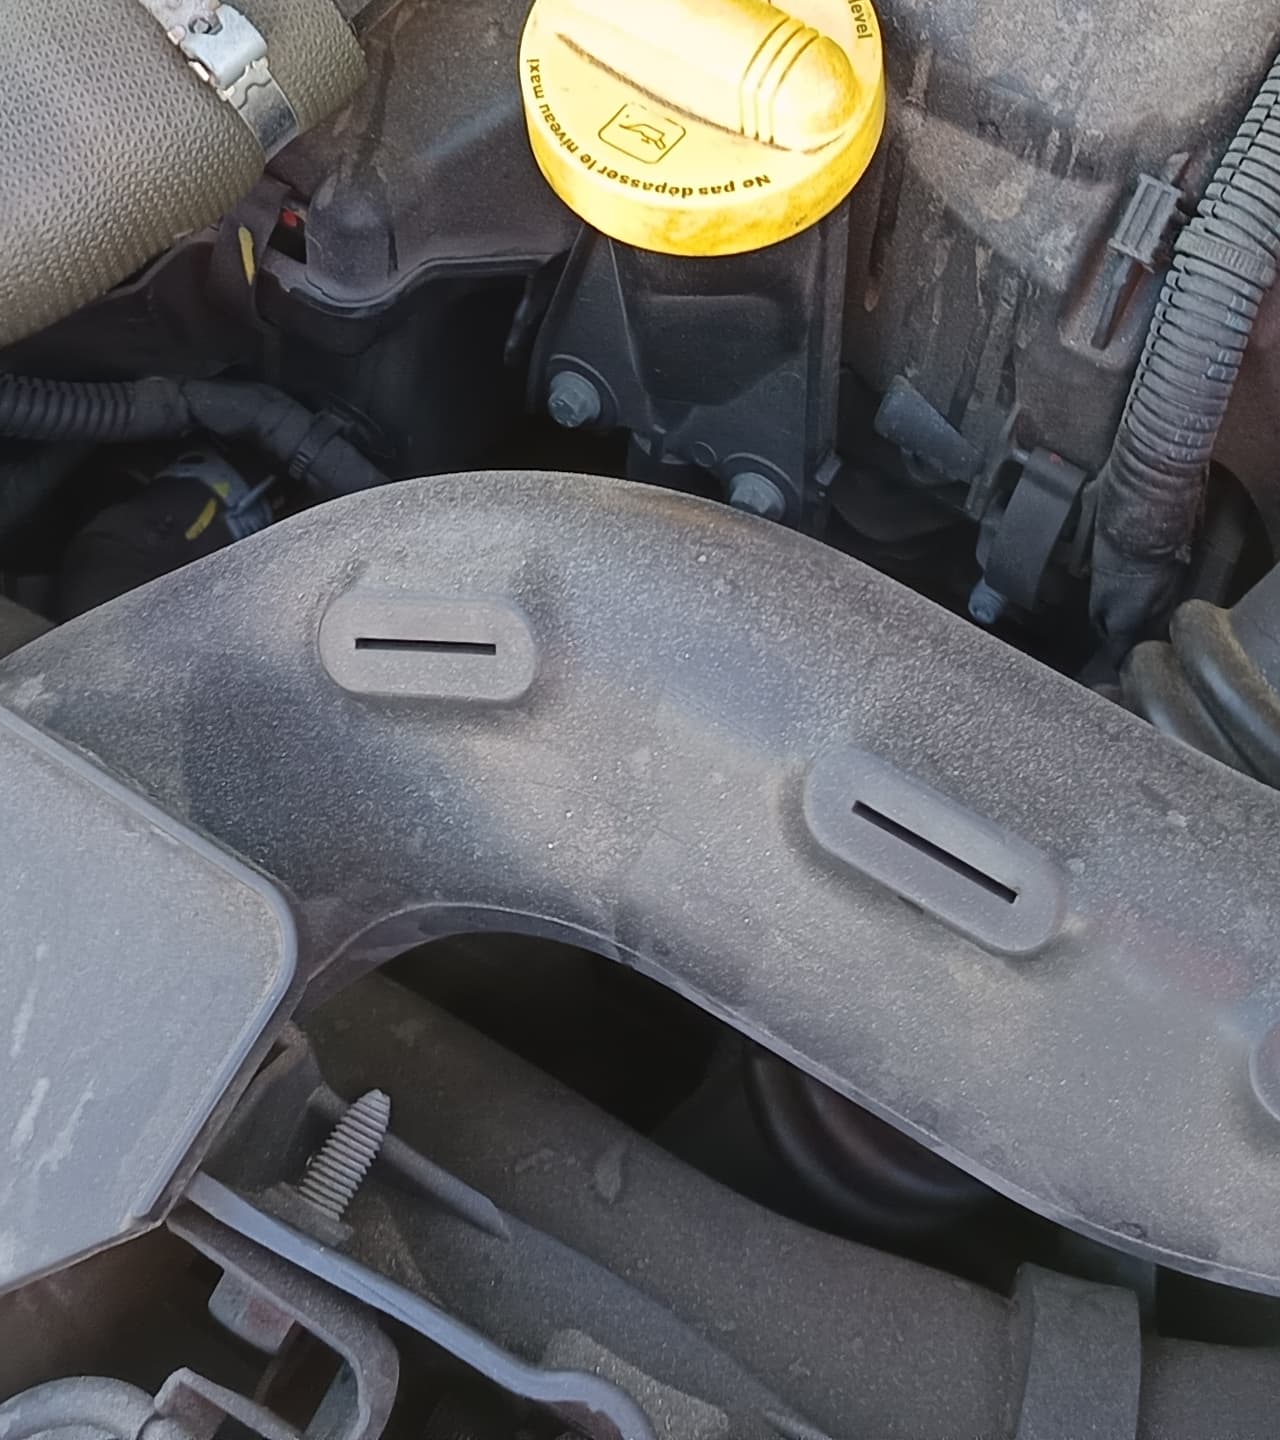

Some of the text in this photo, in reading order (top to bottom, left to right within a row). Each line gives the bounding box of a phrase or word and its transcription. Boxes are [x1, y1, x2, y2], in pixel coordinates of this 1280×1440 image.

[526, 58, 545, 99] maxi
[538, 103, 579, 154] niveau
[579, 153, 597, 170] le
[697, 180, 736, 197] pas
